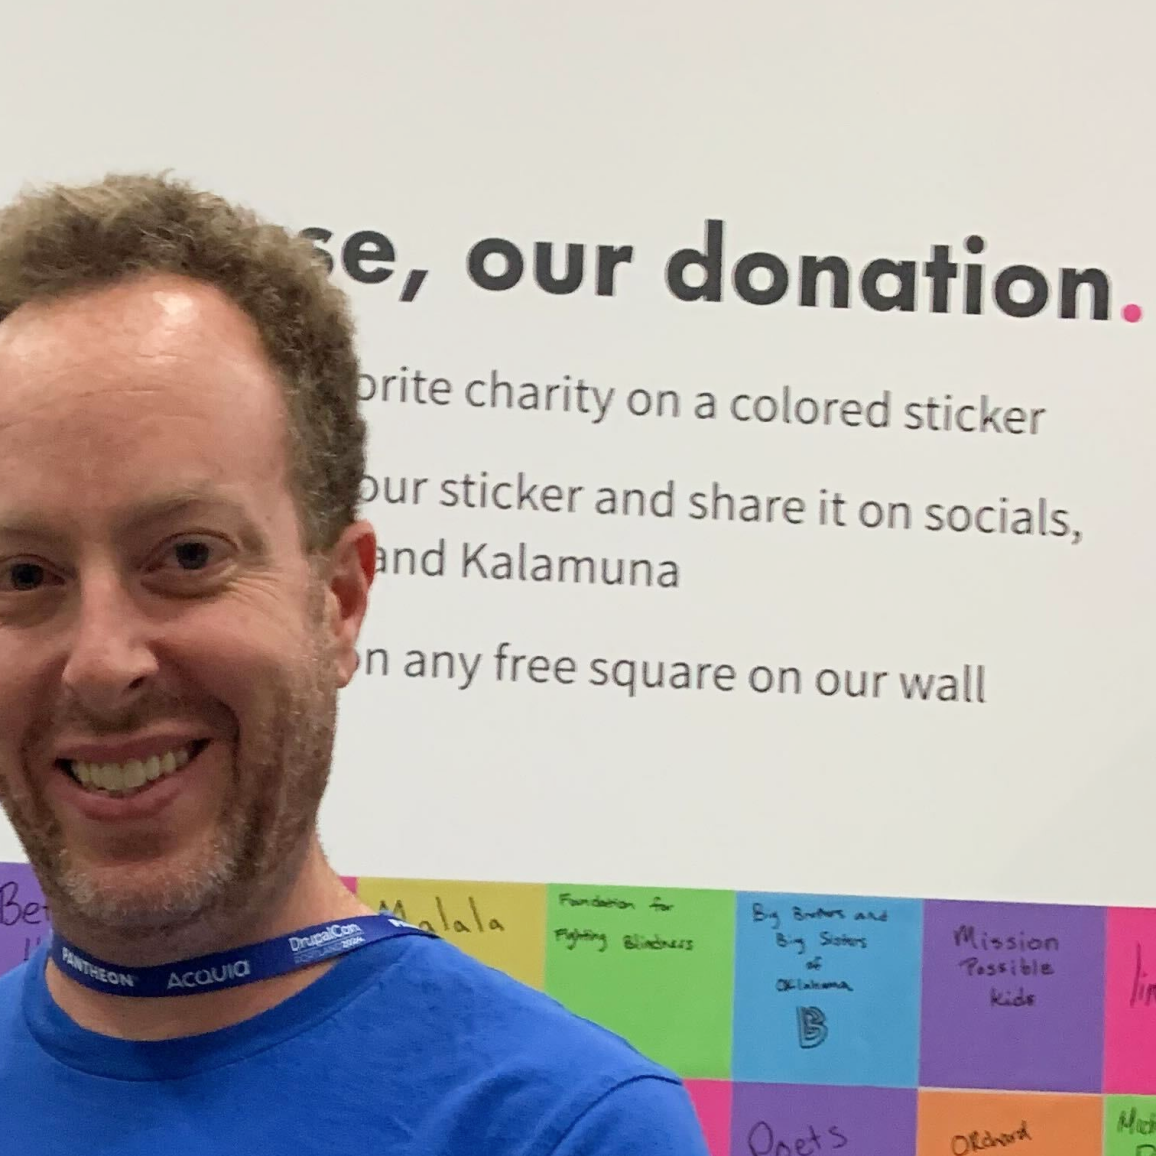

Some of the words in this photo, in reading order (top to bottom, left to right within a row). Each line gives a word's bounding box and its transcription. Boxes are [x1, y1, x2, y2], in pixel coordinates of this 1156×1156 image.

[466, 237, 633, 297] our
[666, 218, 1142, 323] donation.
[465, 370, 614, 424] charity
[627, 388, 680, 418] on
[694, 391, 716, 420] a
[730, 385, 891, 428] colored
[904, 395, 1046, 435] sticker
[439, 472, 584, 514] sticker
[594, 480, 674, 518] and
[688, 481, 806, 525] share
[819, 489, 846, 527] it
[858, 500, 911, 530] on
[924, 498, 1083, 546] socials,
[376, 539, 444, 577] and
[462, 542, 680, 588] Kalamuna
[404, 649, 481, 690] any
[495, 643, 577, 685] free
[589, 657, 736, 698] square
[749, 665, 801, 694] on
[815, 667, 888, 698] our
[900, 664, 986, 704] wall
[62, 947, 135, 988] PANTHEON
[289, 922, 362, 951] DrupalCon
[954, 925, 1059, 951] Mission
[959, 957, 1054, 977] Possible
